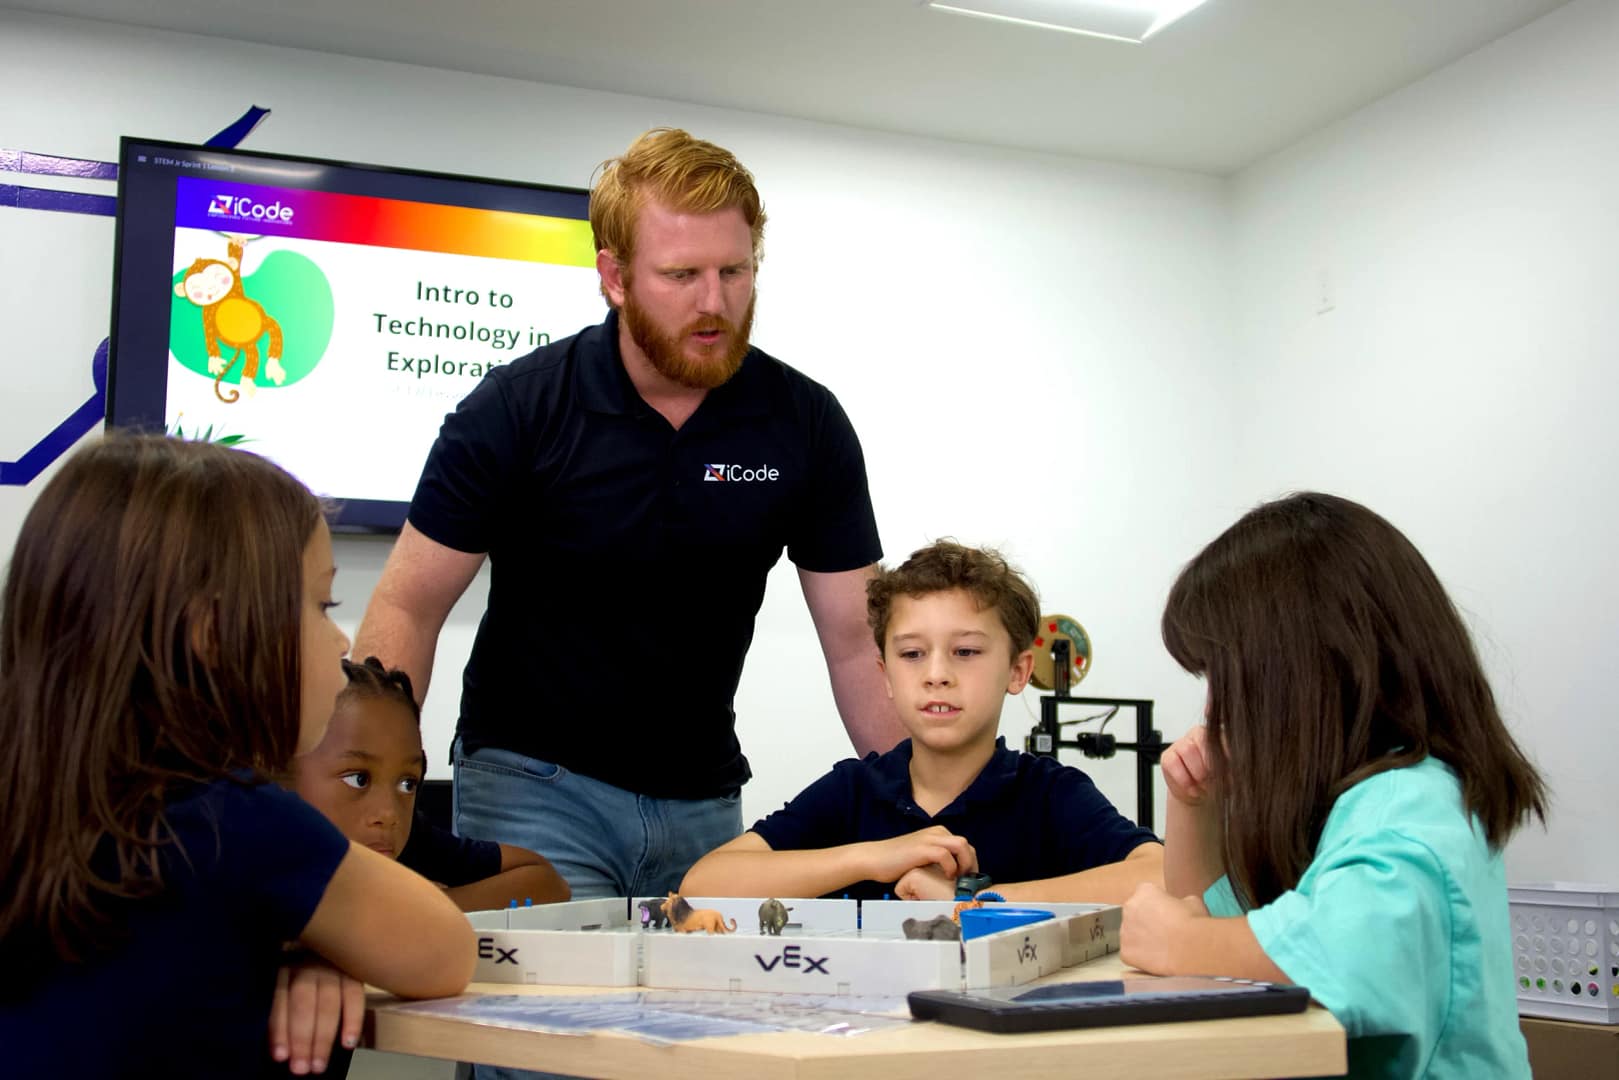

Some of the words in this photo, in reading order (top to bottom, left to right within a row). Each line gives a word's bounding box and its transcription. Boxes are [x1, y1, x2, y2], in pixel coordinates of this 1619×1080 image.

[234, 196, 294, 220] iCode
[416, 280, 480, 305] Intro
[488, 289, 513, 308] to
[373, 313, 520, 350] Technology
[528, 326, 551, 346] in
[387, 351, 503, 379] Explorat
[726, 464, 779, 481] iCode
[477, 937, 519, 965] EX
[754, 945, 829, 975] VEX
